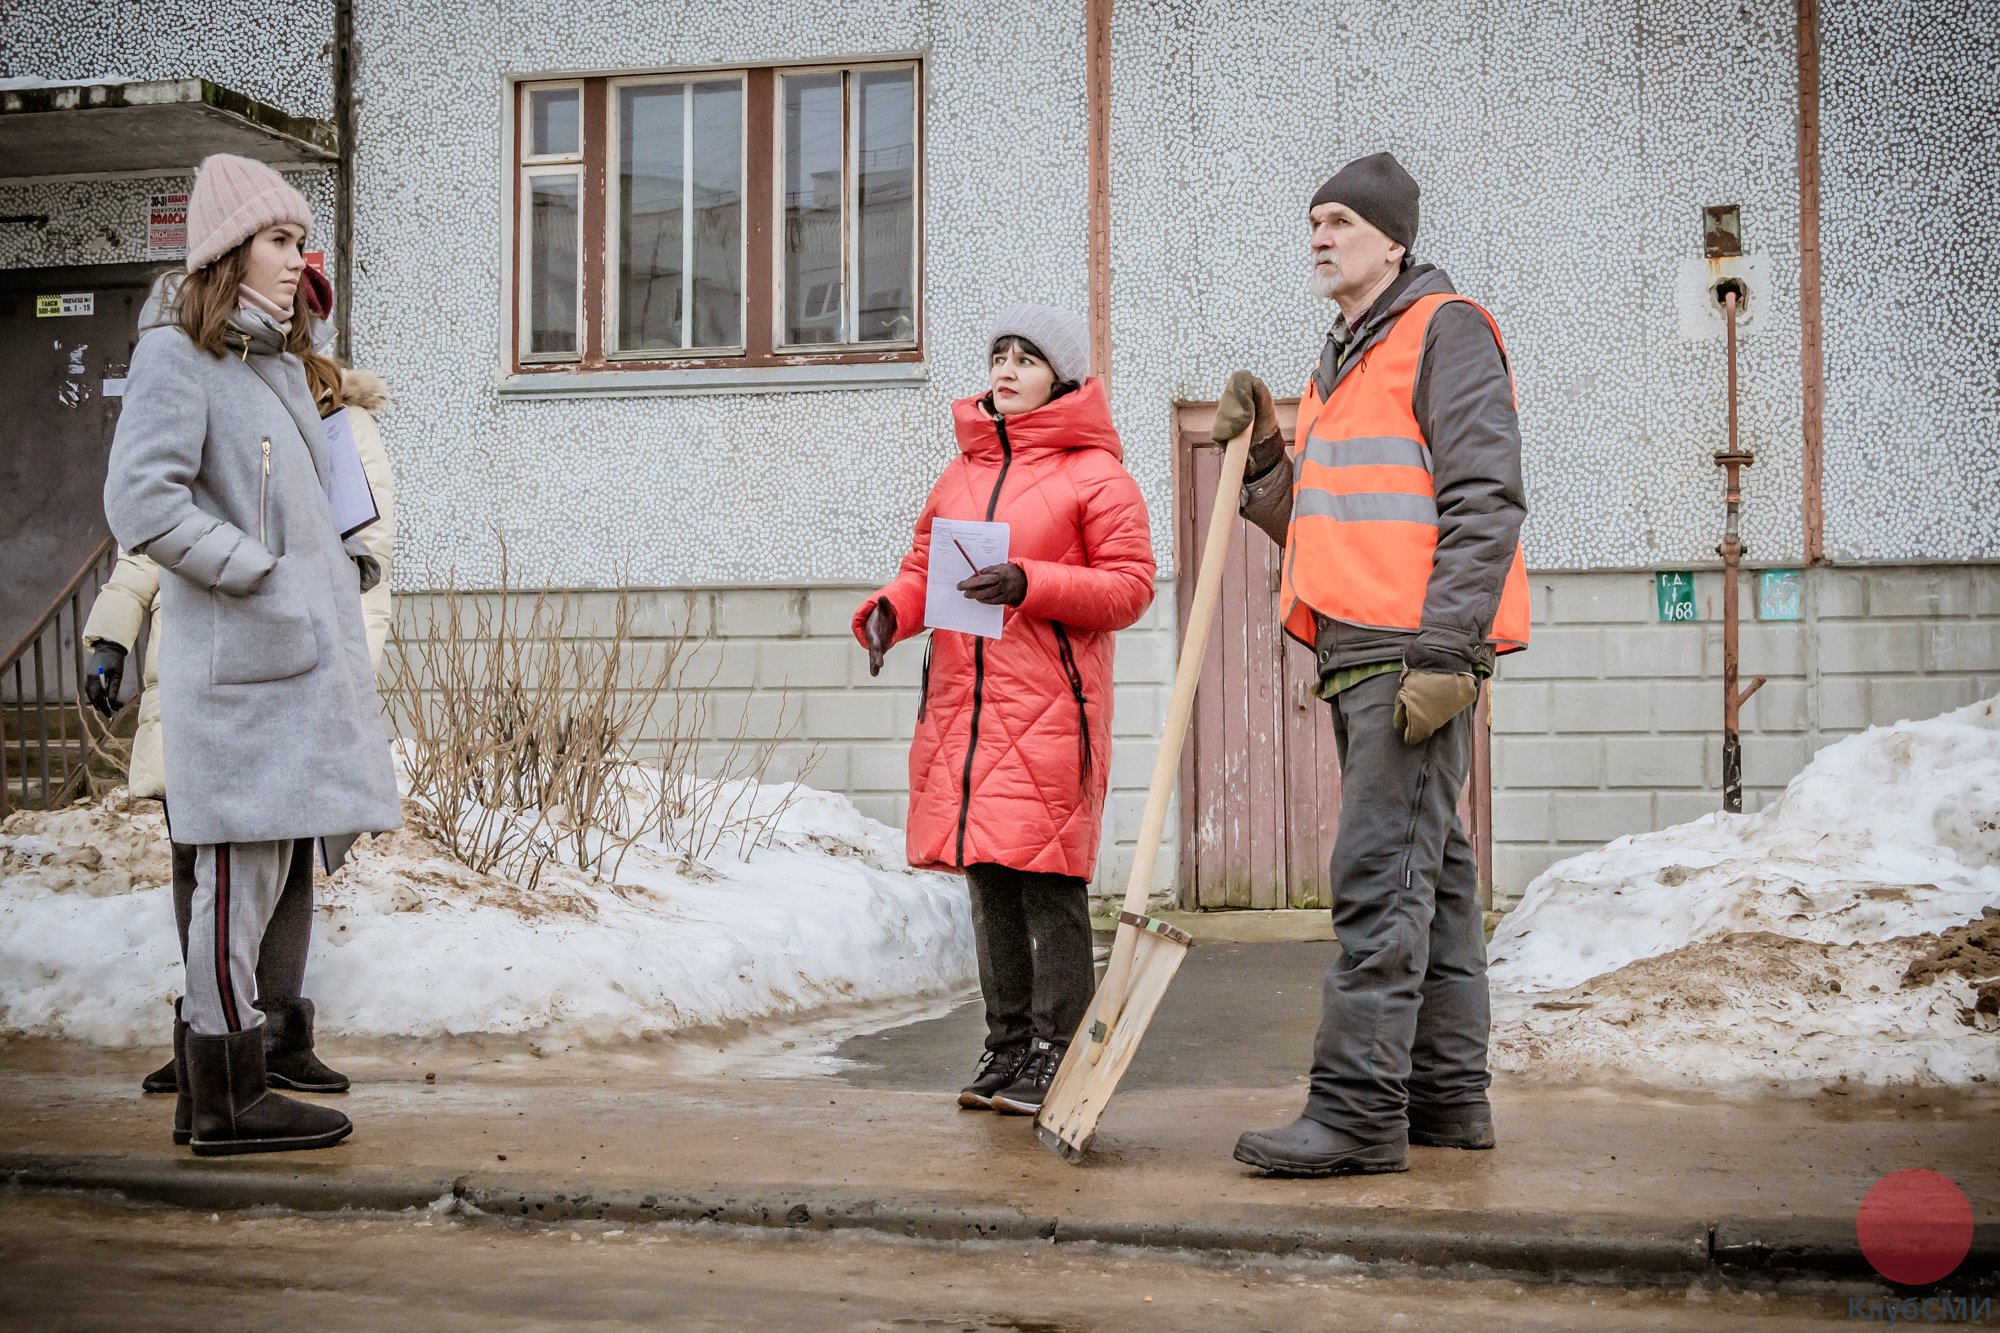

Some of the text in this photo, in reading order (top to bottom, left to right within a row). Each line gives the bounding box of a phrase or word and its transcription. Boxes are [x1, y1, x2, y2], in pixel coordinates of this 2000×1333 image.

[150, 212, 188, 225] ВОЛОСЫ
[84, 304, 91, 312] 15
[1664, 601, 1694, 621] 4.68
